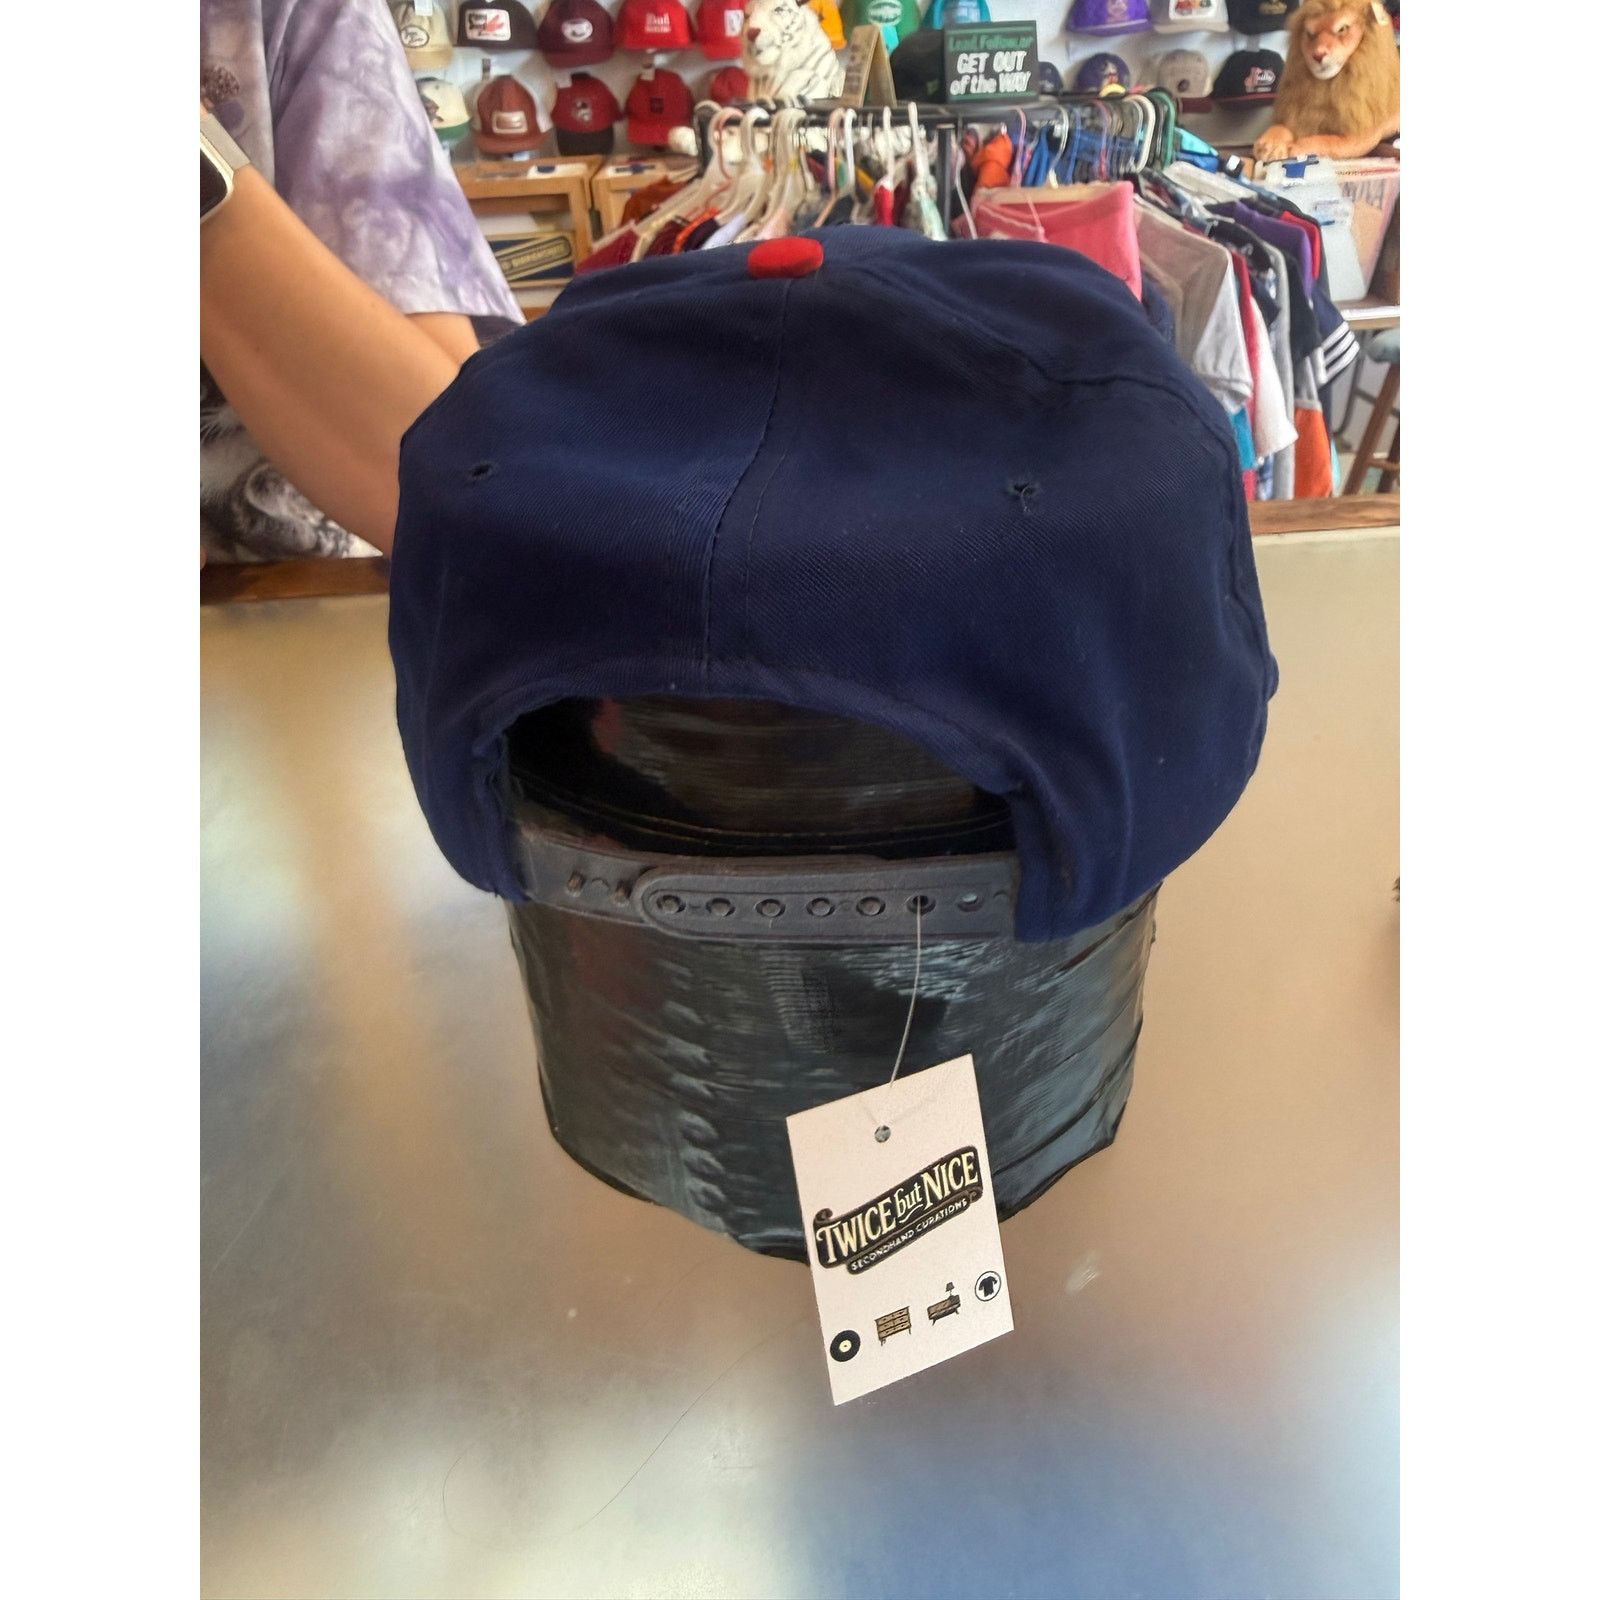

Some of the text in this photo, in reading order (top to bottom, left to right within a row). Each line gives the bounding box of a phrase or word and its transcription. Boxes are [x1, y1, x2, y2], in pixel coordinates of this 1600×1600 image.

[950, 71, 1031, 95] of the WAY
[957, 50, 1027, 74] GET OUT
[815, 1151, 979, 1263] TWICE but NICE
[851, 1198, 967, 1271] SECONDHAND CURATIONS
